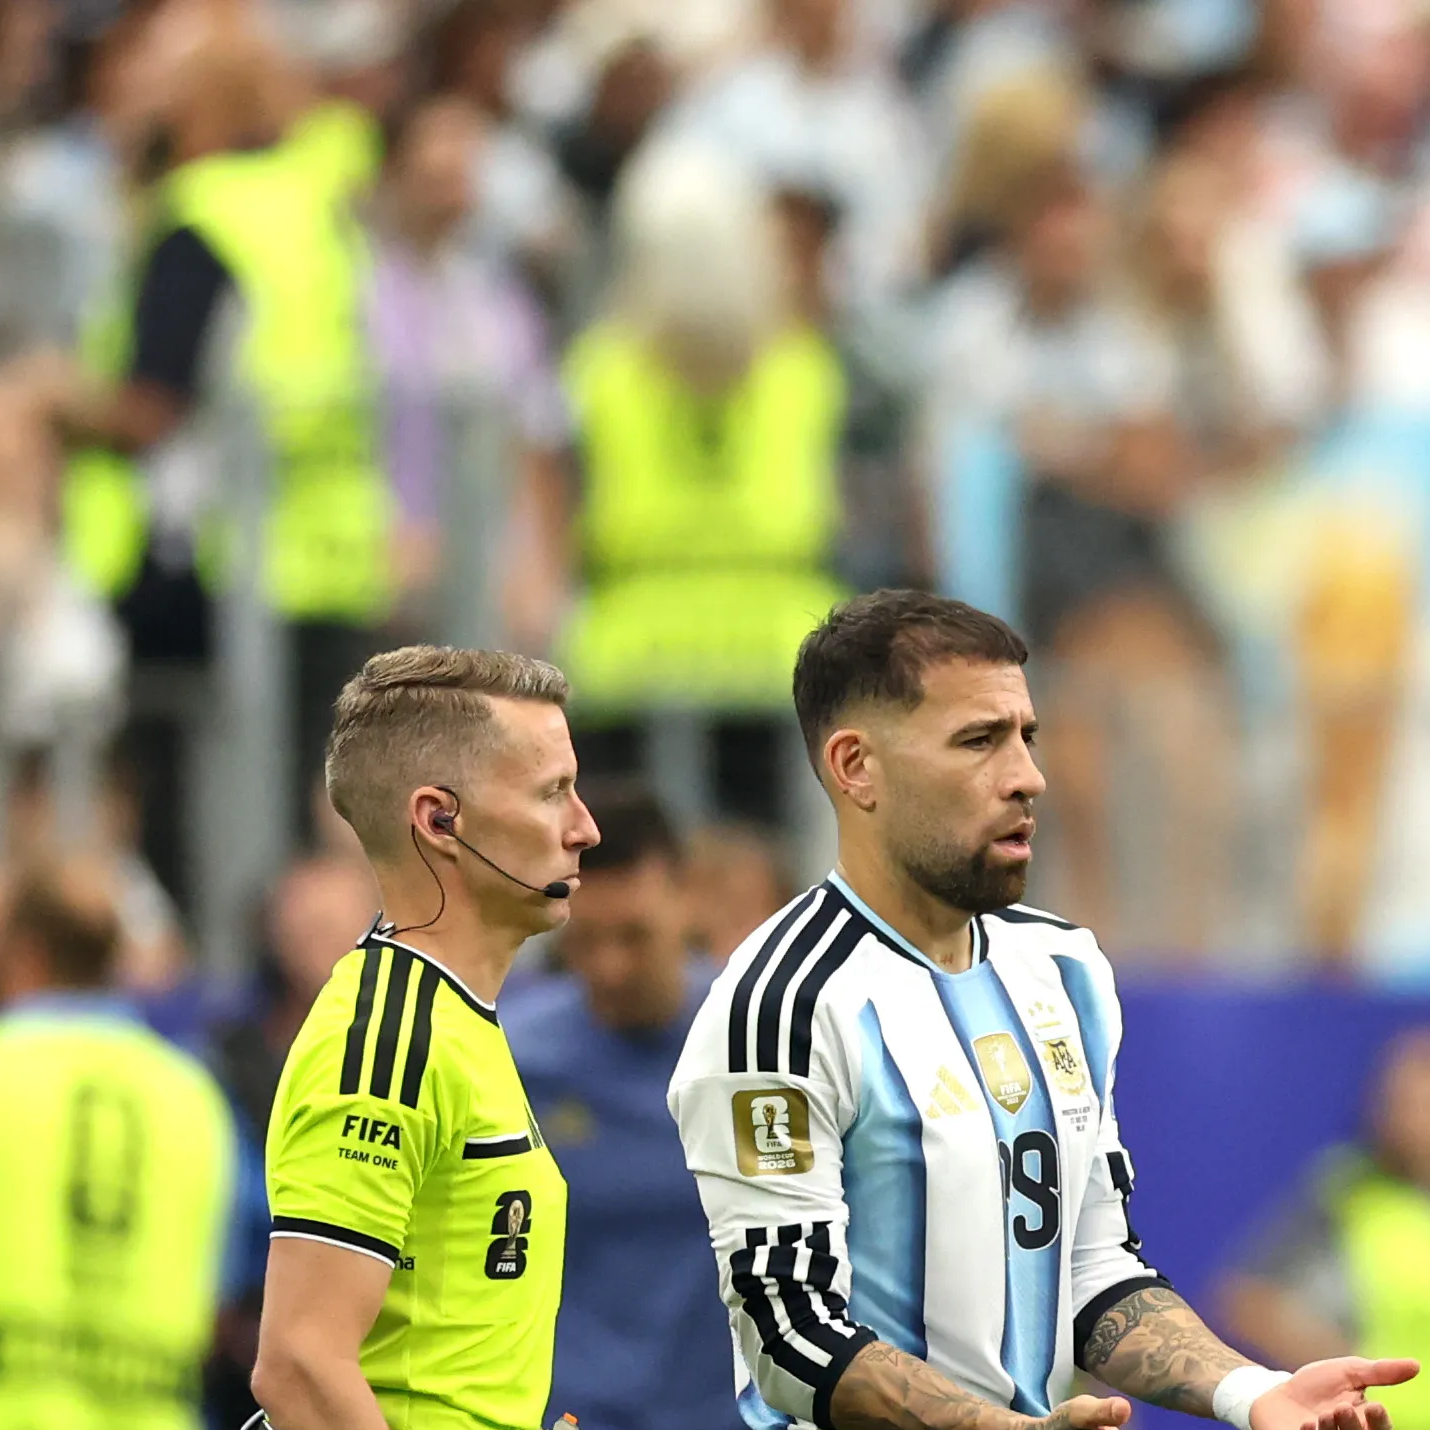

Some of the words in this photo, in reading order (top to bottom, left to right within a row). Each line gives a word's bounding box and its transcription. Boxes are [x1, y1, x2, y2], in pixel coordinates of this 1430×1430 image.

[341, 1115, 400, 1150] FIFA
[338, 1148, 370, 1163] TEAM
[373, 1155, 399, 1170] ONE
[758, 1159, 796, 1170] 2026
[496, 1262, 517, 1273] FIFA
